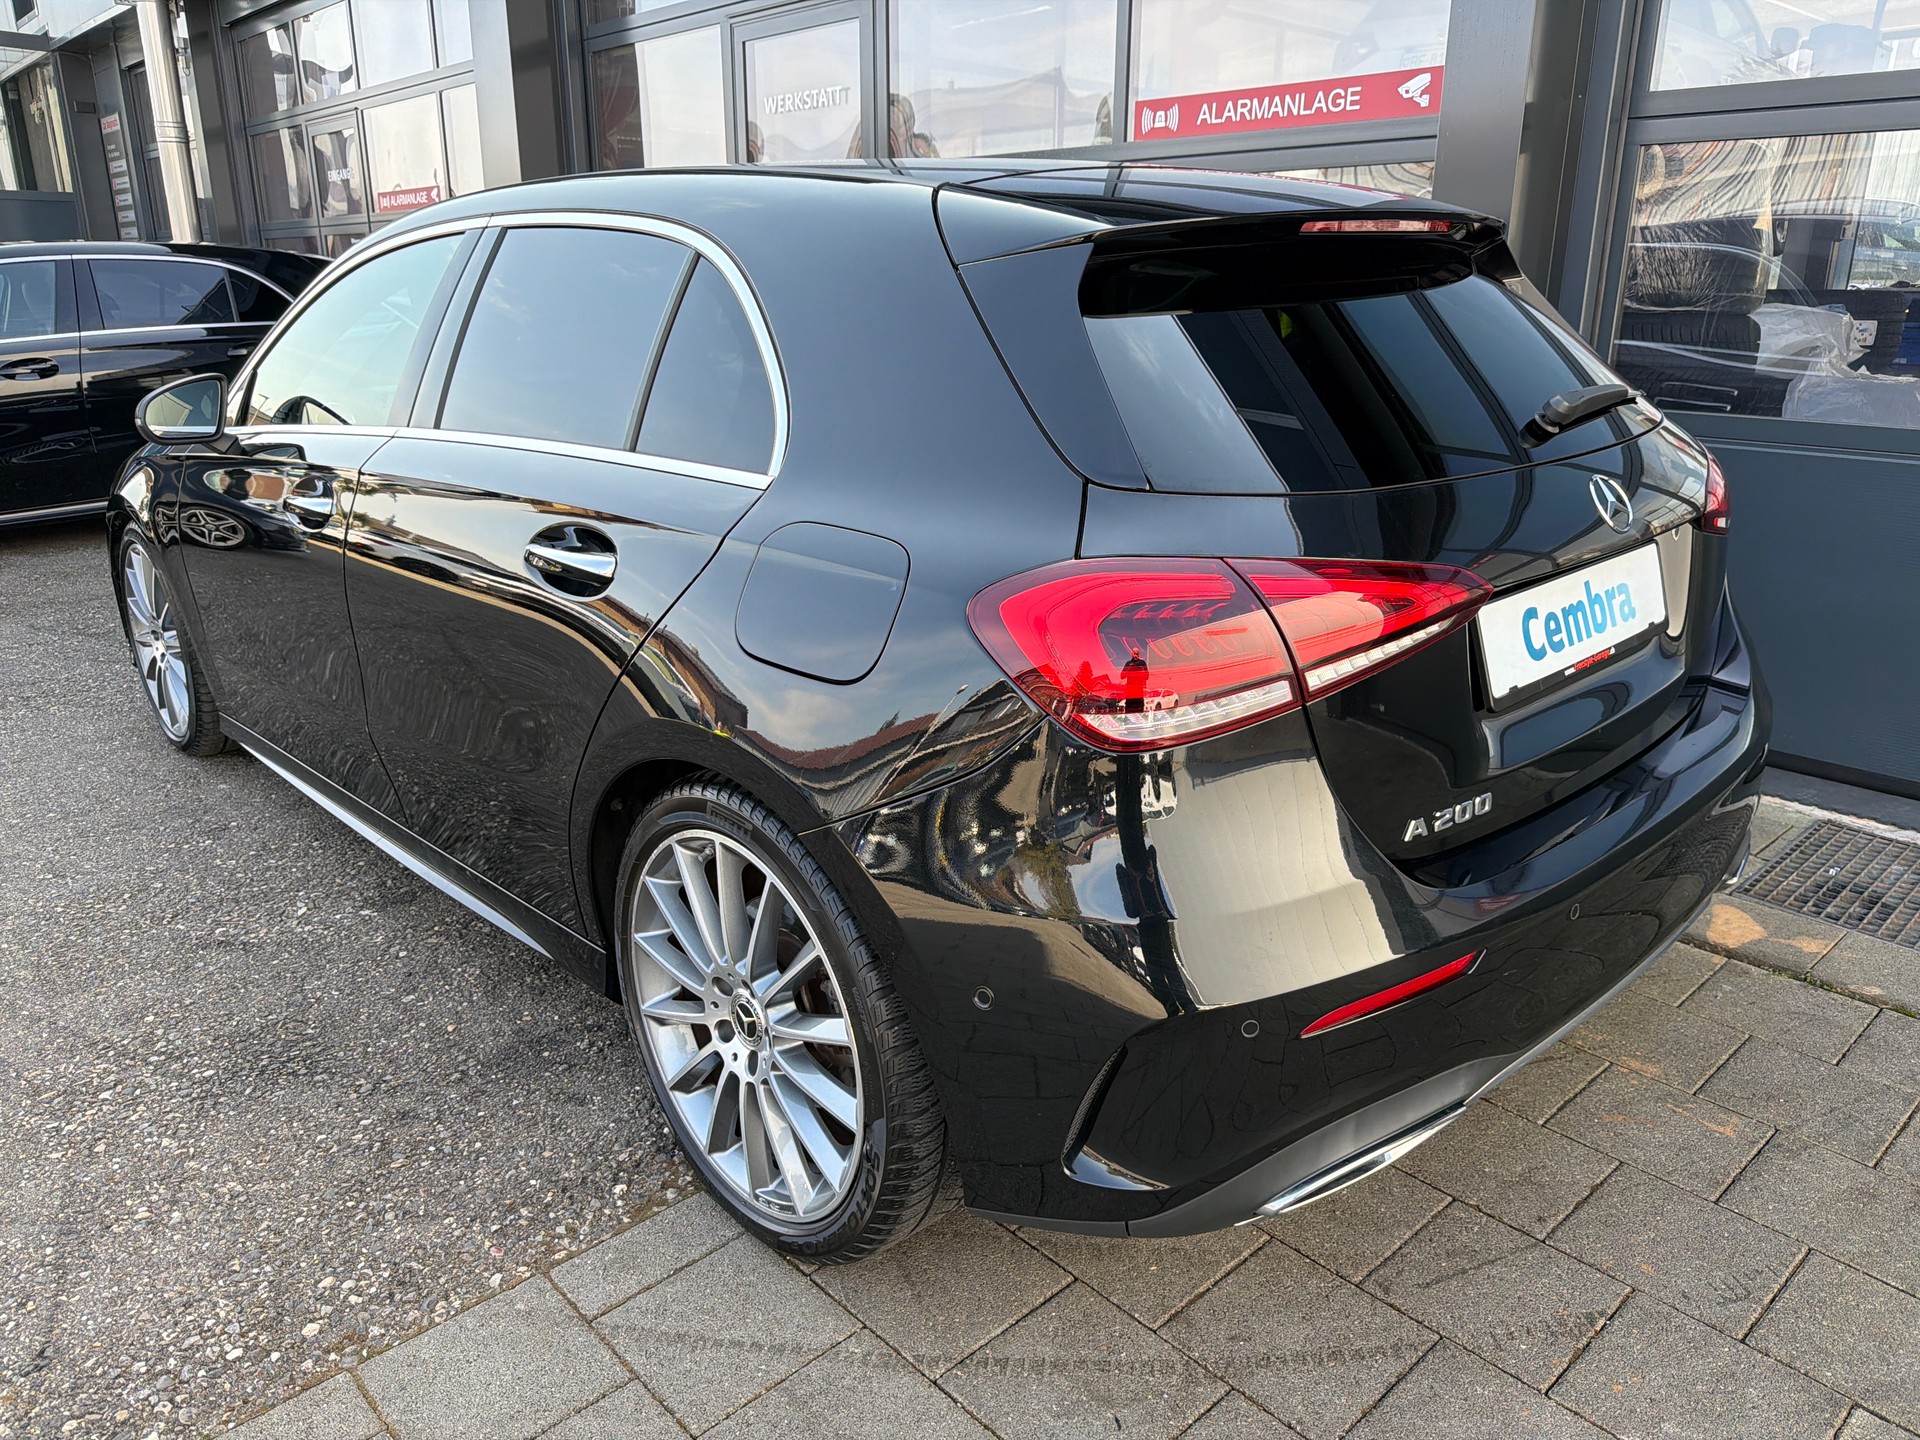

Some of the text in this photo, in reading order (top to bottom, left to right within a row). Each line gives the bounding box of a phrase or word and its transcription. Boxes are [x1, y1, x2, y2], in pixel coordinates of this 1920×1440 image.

[764, 86, 842, 114] WERKSTATT
[1197, 86, 1362, 125] ALARMANLAGE
[390, 191, 429, 206] ALARMANLAGE
[1521, 579, 1636, 661] Cembra
[1402, 792, 1492, 842] A 200
